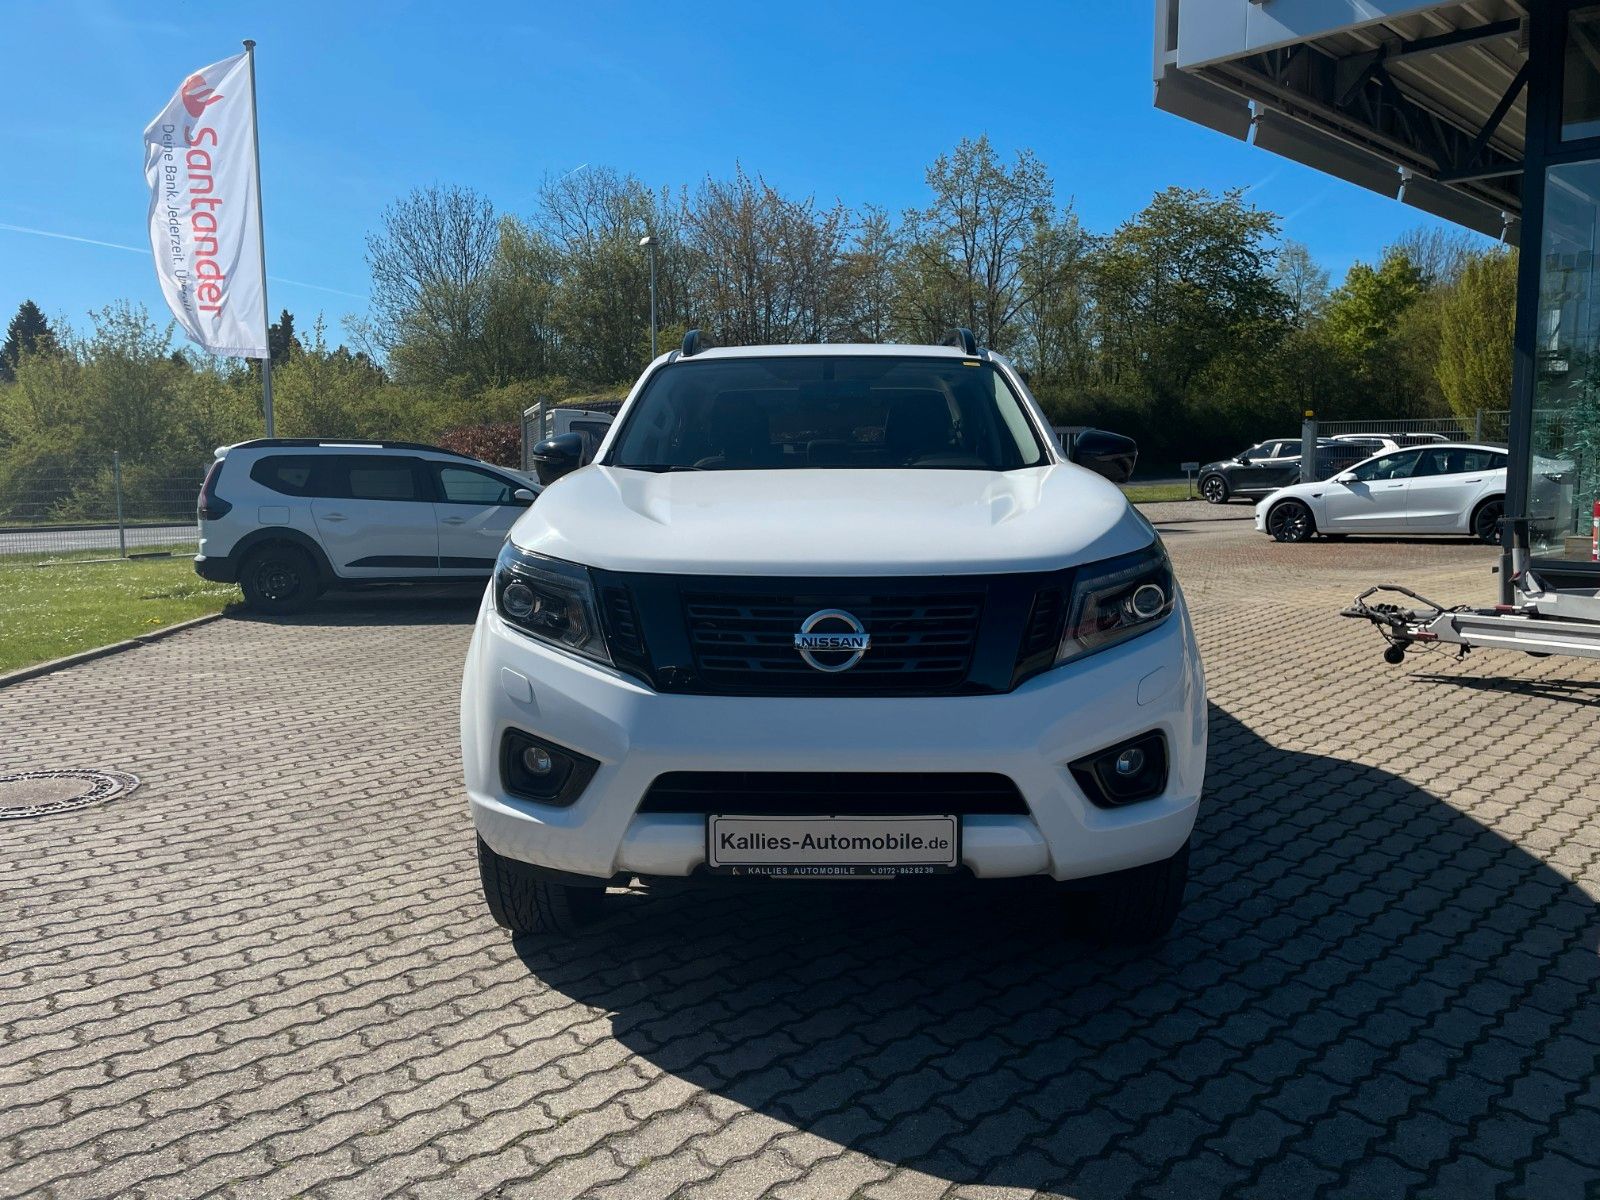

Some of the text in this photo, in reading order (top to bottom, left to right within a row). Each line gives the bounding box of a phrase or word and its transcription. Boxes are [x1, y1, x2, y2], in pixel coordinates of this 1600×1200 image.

[162, 124, 175, 161] Deine
[165, 165, 180, 201] Bank.
[167, 204, 185, 265] Jederzeit.
[184, 126, 226, 317] Santander
[801, 637, 864, 647] NISSAN
[720, 833, 948, 850] Kallies-Automobile.de
[748, 867, 788, 875] KALLIES
[793, 867, 855, 875] AUTOMOBILE
